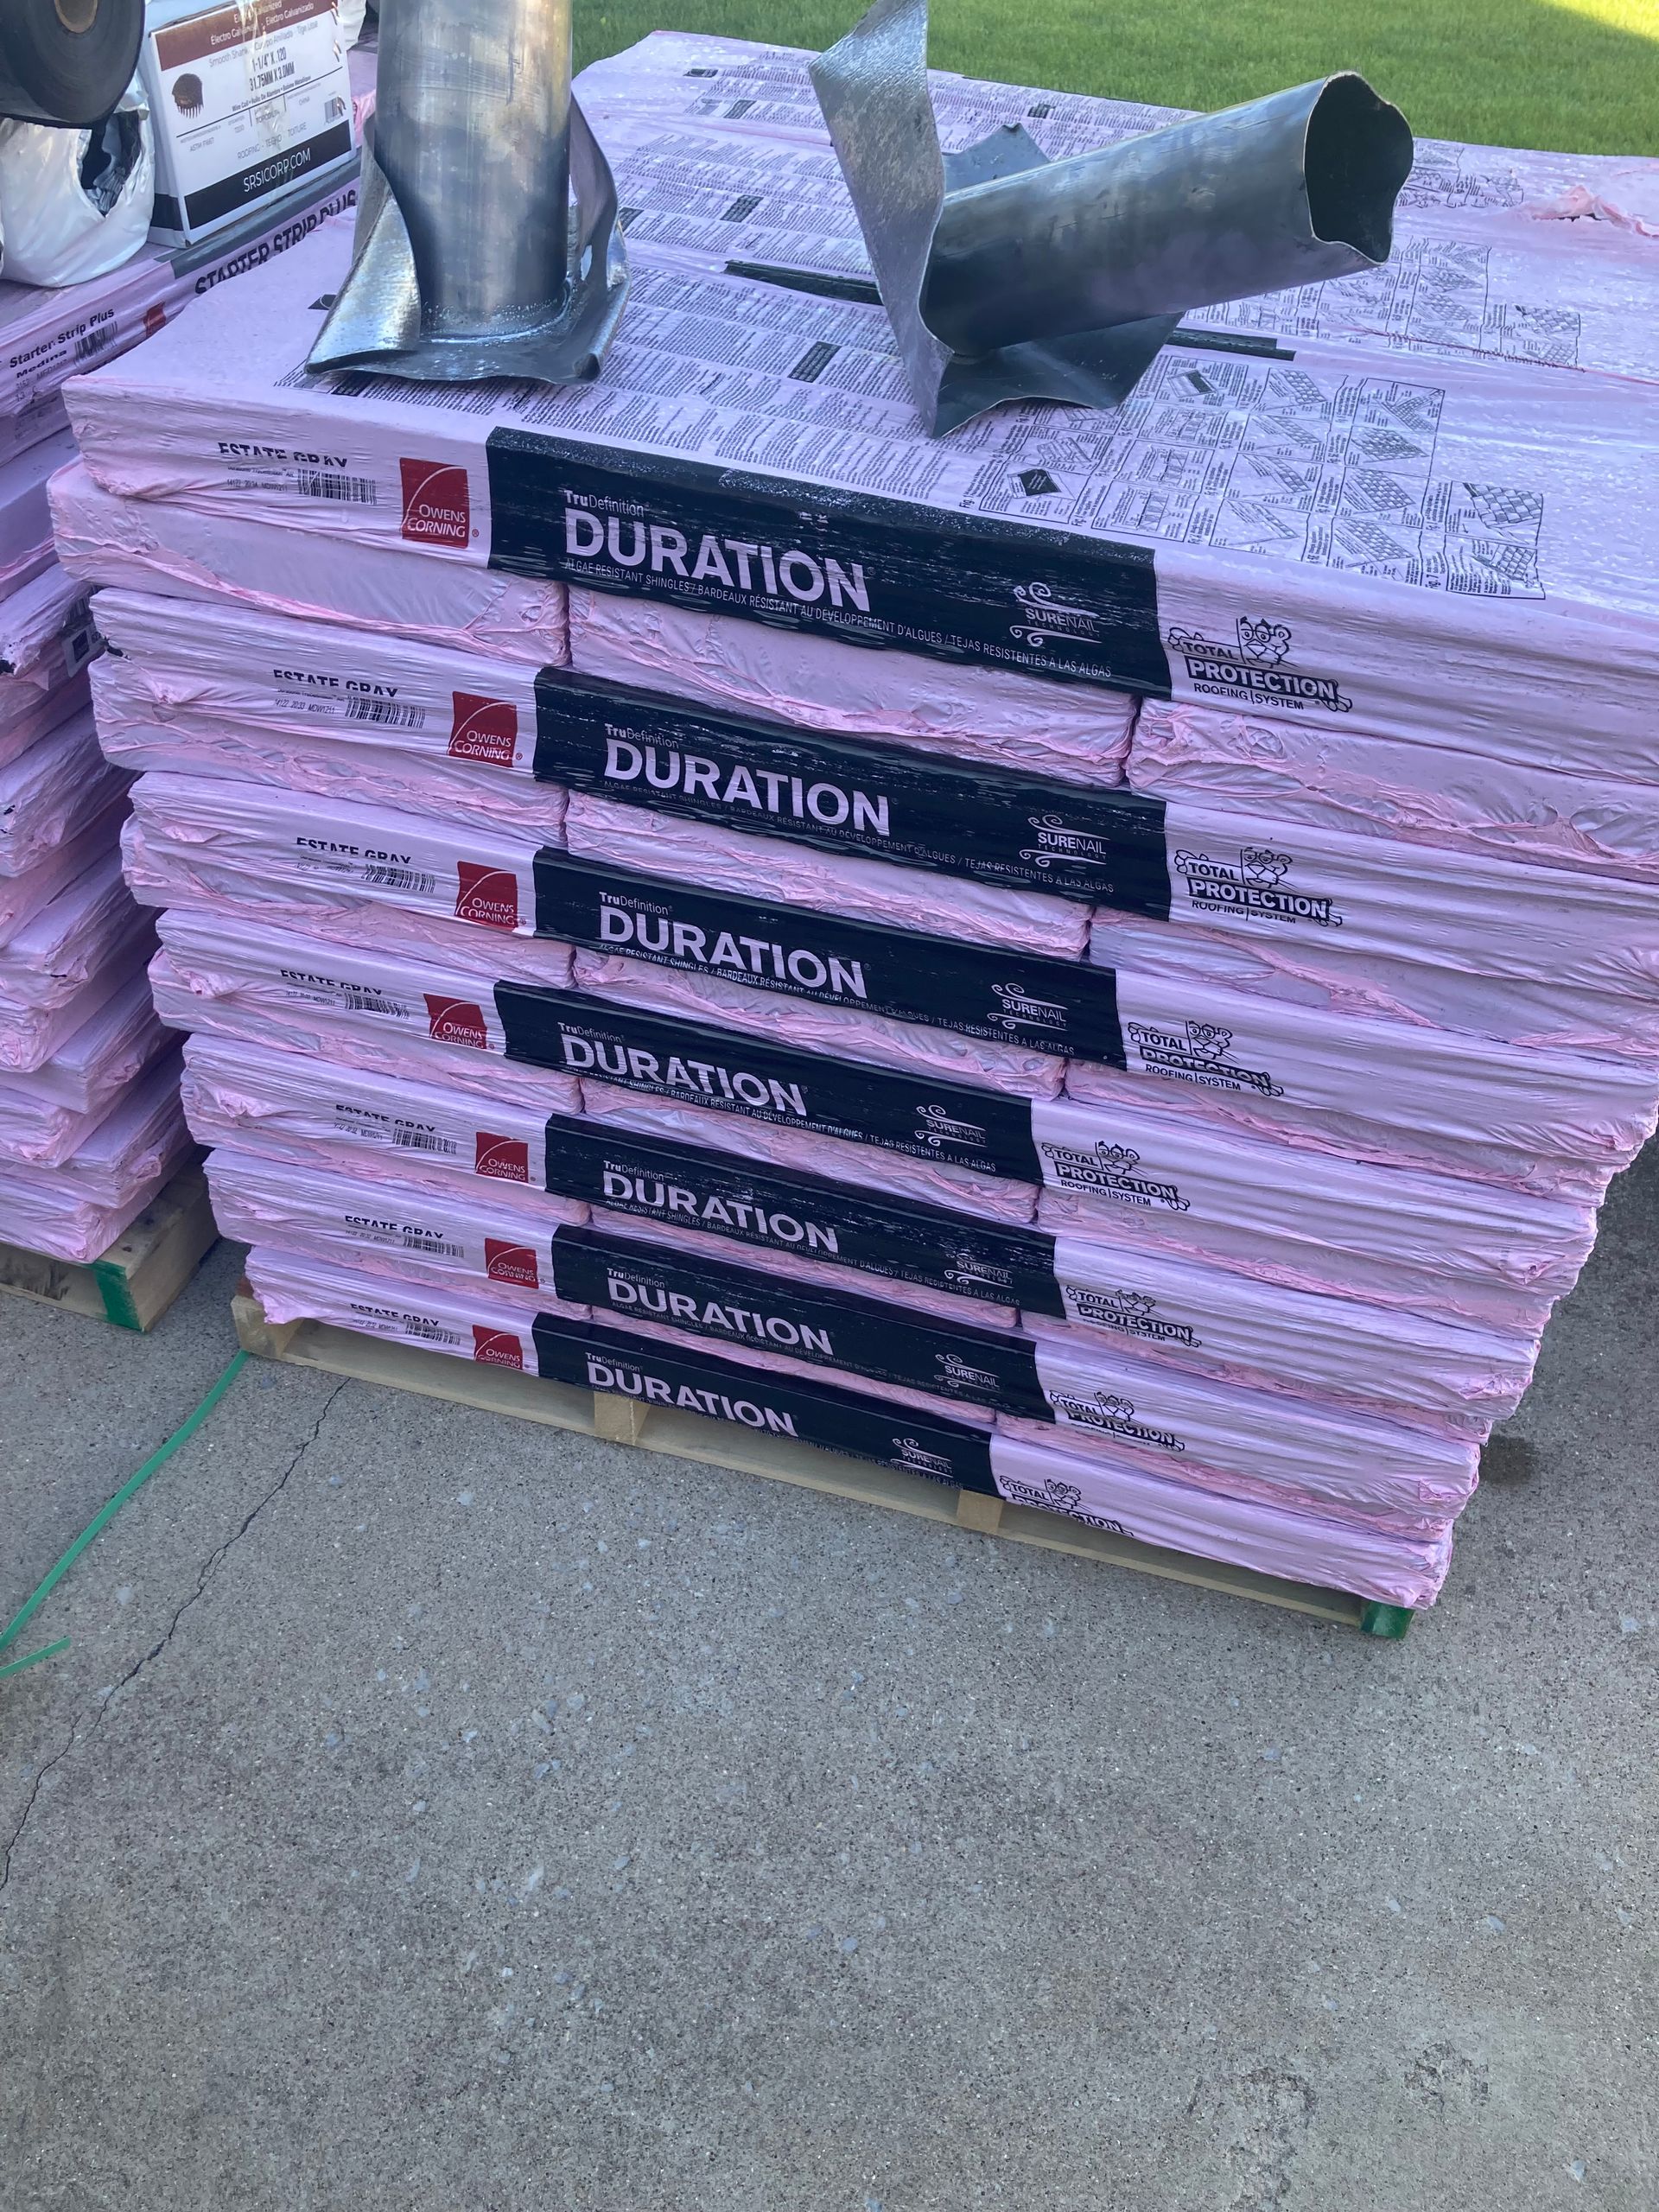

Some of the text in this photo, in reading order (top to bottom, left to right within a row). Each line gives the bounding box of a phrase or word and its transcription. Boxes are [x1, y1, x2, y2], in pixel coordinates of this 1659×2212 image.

[284, 2, 315, 20] Galvanizado
[209, 53, 232, 67] Smooth
[249, 61, 296, 92] 31.75MM 3.0MM
[244, 147, 311, 193] SRSICORP.COM
[274, 213, 317, 254] STRIP
[10, 308, 115, 369] Starter Strip Plus
[16, 349, 67, 378] Medina
[218, 442, 347, 467] ESTATE GRAY
[419, 504, 466, 523] OWENS
[563, 490, 644, 518] TruDefinition
[408, 518, 465, 537] CORNING
[565, 508, 870, 612] DURATION
[565, 560, 1112, 678] ALGAE RESISTANT SHINGLES BARDEAUX RÉSISTANT AU DÉVELOPPEMENT D'ALGUES TEJAS RESISTENTES A LAS ALGAS
[1026, 607, 1100, 633] SURENAIL
[1183, 642, 1237, 661] TOTAL
[274, 670, 339, 687] ESTATE
[346, 681, 398, 698] GRAY
[1188, 658, 1336, 699] PROTECTION
[467, 730, 512, 747] OWENS
[604, 723, 679, 749] TruDefinition
[454, 741, 510, 760] CORNING
[604, 738, 890, 836] DURATION
[296, 836, 359, 855] ESTATE
[365, 849, 411, 864] GRAY
[1038, 832, 1106, 855] SURENAIL
[1038, 843, 1107, 860] TECHNOLOGY
[826, 827, 837, 837] AU
[965, 858, 992, 870] TEJAS
[995, 863, 1053, 884] RESISTENTES
[1056, 875, 1062, 885] A
[1064, 877, 1081, 887] LAS
[1084, 879, 1114, 893] ALGAS
[1188, 861, 1239, 881] TOTAL
[472, 898, 514, 913] OWENS
[1192, 880, 1327, 918] PROTECTION
[460, 906, 514, 925] CORNING
[599, 906, 867, 999] DURATION
[280, 969, 335, 985] ESTATE
[716, 968, 758, 985] BARDEAUX
[760, 976, 804, 994] RÉSISTANT
[938, 1016, 963, 1031] TEJAS
[965, 1023, 1019, 1044] RESISTENTES
[1030, 1039, 1046, 1051] LAS
[1002, 999, 1066, 1022] SURENAIL
[435, 1032, 484, 1048] CORNING
[442, 1022, 483, 1040] OWENS
[1141, 1032, 1187, 1052] TOTAL
[561, 1033, 807, 1116] DURATION
[1143, 1048, 1269, 1087] PROTECTION
[336, 1104, 390, 1122] ESTATE
[710, 1096, 750, 1116] RÉSISTANT
[870, 1135, 894, 1147] TEJAS
[896, 1142, 945, 1160] RESISTENTES
[955, 1157, 969, 1166] LAS
[970, 1160, 995, 1172] ALGAS
[926, 1119, 985, 1139] SURENAIL
[488, 1159, 525, 1173] OWENS
[1055, 1149, 1099, 1166] TOTAL
[480, 1165, 525, 1180] CORNING
[1058, 1164, 1176, 1198] PROTECTION
[603, 1170, 838, 1253] DURATION
[667, 1210, 700, 1226] SHINGLES
[346, 1216, 397, 1230] ESTATE
[403, 1226, 443, 1239] GRAY
[498, 1262, 534, 1275] OWENS
[957, 1261, 1010, 1279] SURENAIL
[351, 1303, 398, 1318] ESTATE
[1077, 1292, 1119, 1308] TOTAL
[607, 1277, 834, 1356] DURATION
[1080, 1306, 1191, 1339] PROTECTION
[477, 1354, 519, 1369] CORNING
[486, 1349, 520, 1362] OWENS
[944, 1365, 1000, 1388] SURENAIL
[587, 1362, 798, 1437] DURATION
[1061, 1399, 1101, 1415] TOTAL
[1070, 1411, 1173, 1444] PROTECTION
[901, 1449, 951, 1469] SURENAIL
[1012, 1484, 1050, 1501] TOTAL
